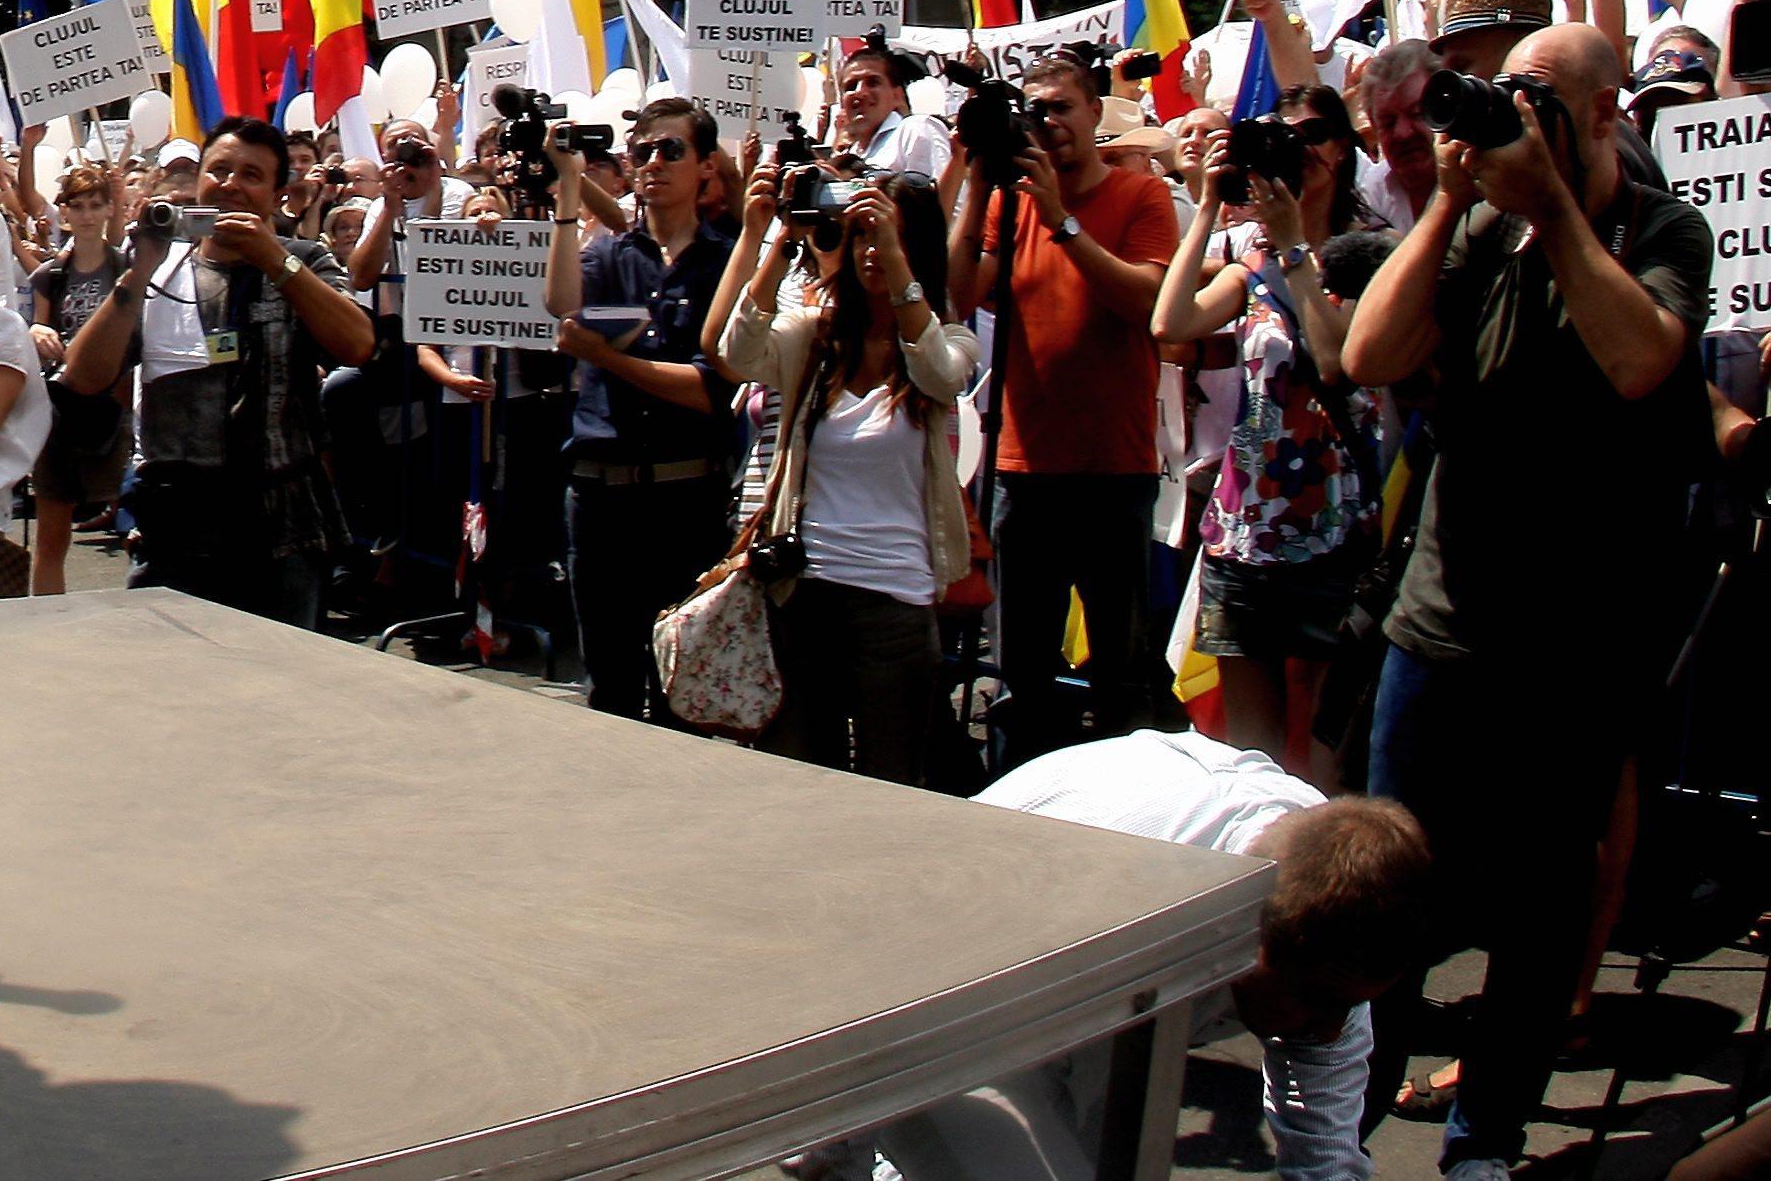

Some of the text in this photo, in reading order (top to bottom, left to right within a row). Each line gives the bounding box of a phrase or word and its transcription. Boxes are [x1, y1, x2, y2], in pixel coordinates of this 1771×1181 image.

[256, 2, 278, 14] TA!
[379, 4, 397, 21] DE
[719, 0, 793, 15] CLUJUL
[871, 0, 900, 16] TA!
[34, 17, 101, 48] CLUJUL
[696, 25, 720, 40] TE
[53, 44, 96, 69] ESTE
[19, 55, 145, 107] DE PARTEA TA!
[716, 99, 771, 122] PARTA
[1671, 172, 1746, 207] ESTI
[420, 227, 521, 251] TRAIANE,
[416, 257, 464, 275] ESTI
[445, 288, 529, 308] CLUJUL
[418, 316, 446, 334] TE
